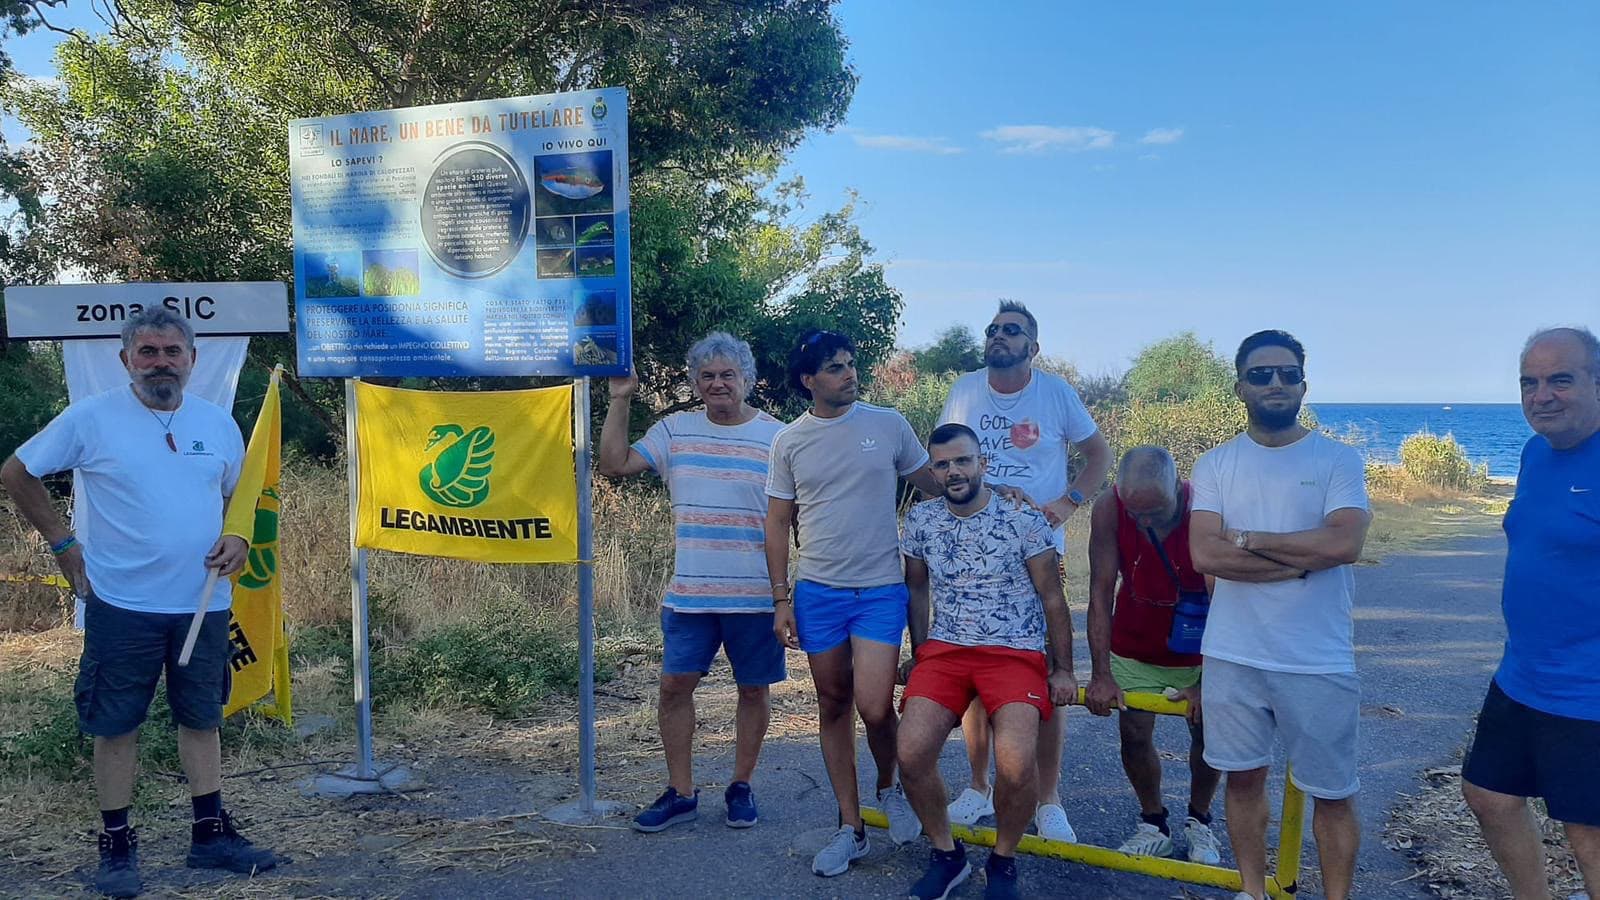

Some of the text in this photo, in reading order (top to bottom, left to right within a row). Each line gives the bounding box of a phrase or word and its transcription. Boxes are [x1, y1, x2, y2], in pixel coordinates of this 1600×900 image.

[330, 106, 584, 146] IL MARE, UN BENE DA TUTELARE
[542, 138, 606, 151] IO VIVO QUI
[331, 159, 342, 168] LO
[346, 156, 376, 166] SAPEVI
[76, 296, 216, 322] zona SIC
[306, 301, 468, 314] PROTEGGERE LA POSIDONIA SIGNIFICA
[306, 314, 468, 328] PRESERVARE LA BELLEZZA E LA SALUTE
[307, 330, 322, 340] DEL
[325, 330, 360, 340] NOSTRO
[399, 341, 430, 350] IMPEGNO
[430, 340, 470, 350] COLLETTIVO
[980, 414, 1015, 430] GOD
[979, 436, 1014, 450] AVE
[380, 507, 552, 540] LEGAMBIENTE
